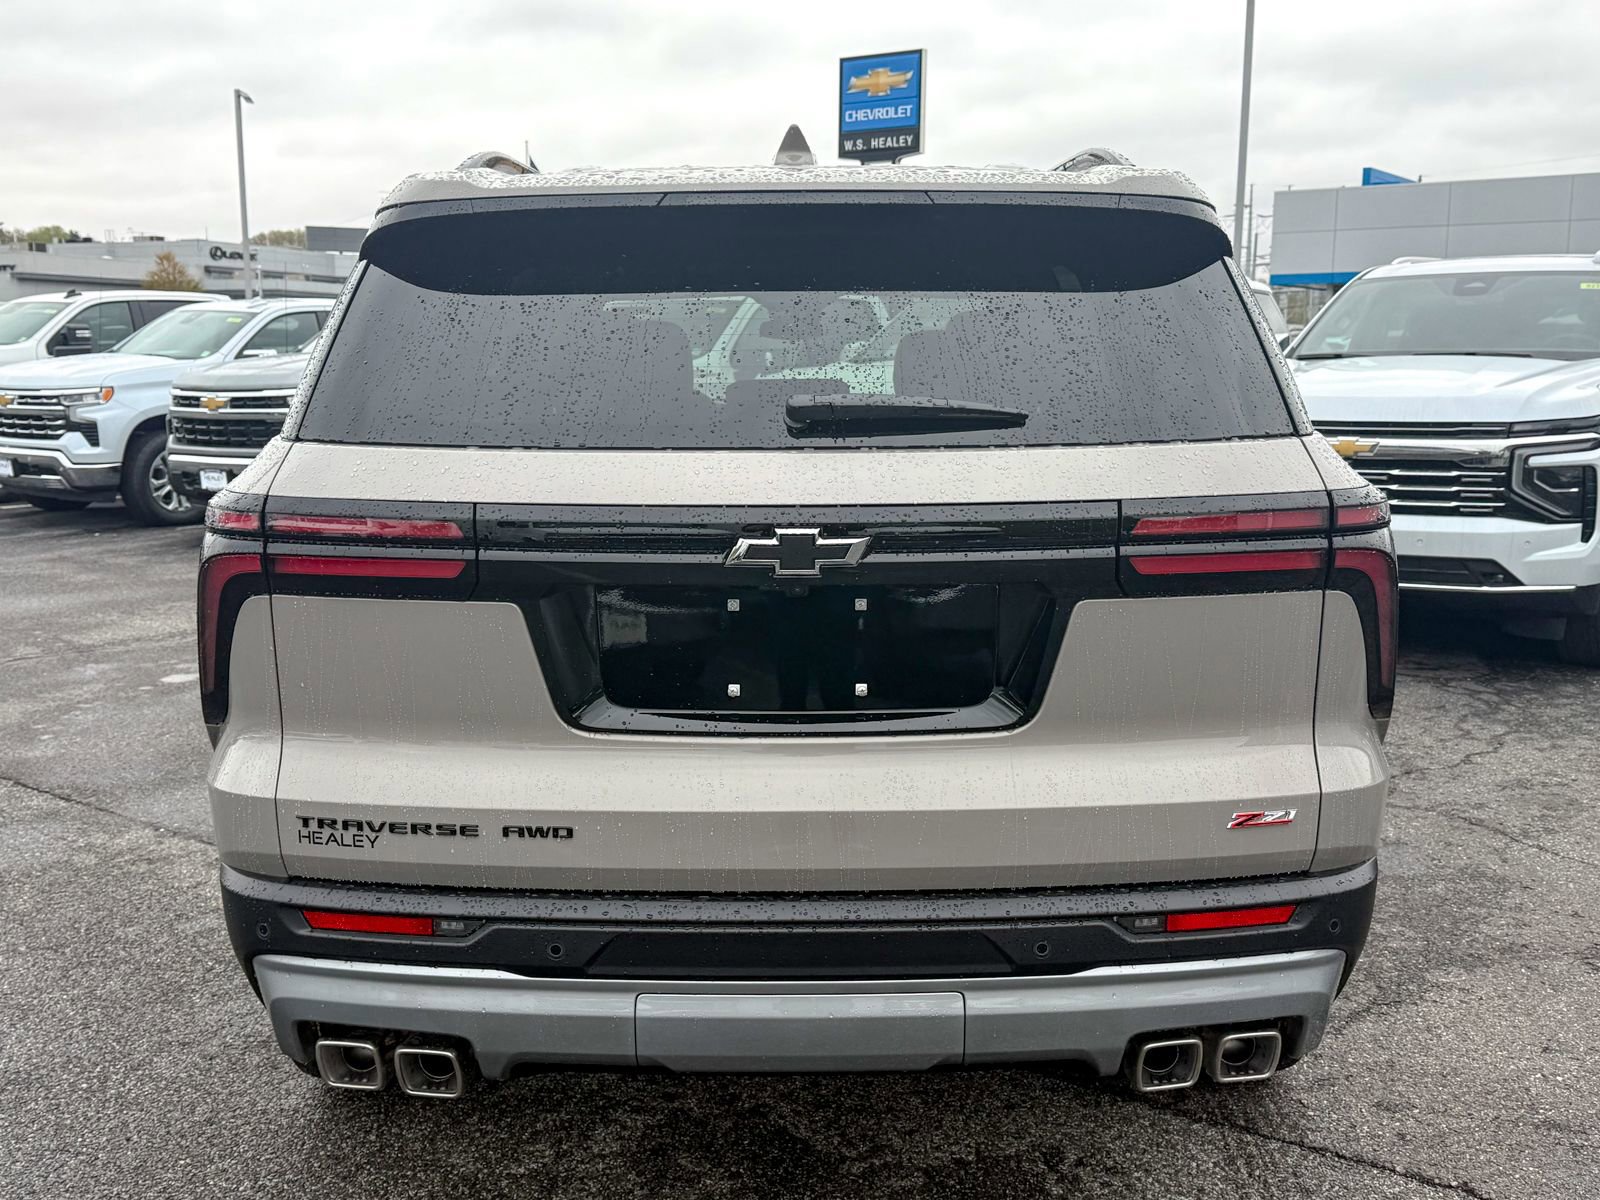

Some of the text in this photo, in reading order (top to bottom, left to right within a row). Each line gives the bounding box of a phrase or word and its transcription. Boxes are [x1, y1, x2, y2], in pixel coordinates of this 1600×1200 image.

[845, 104, 913, 122] CHEVROLET
[844, 135, 913, 151] W.S. HEALEY
[295, 815, 573, 839] TRAVERSE AWD
[1226, 808, 1298, 829] Z71
[297, 829, 380, 849] HEALEY
